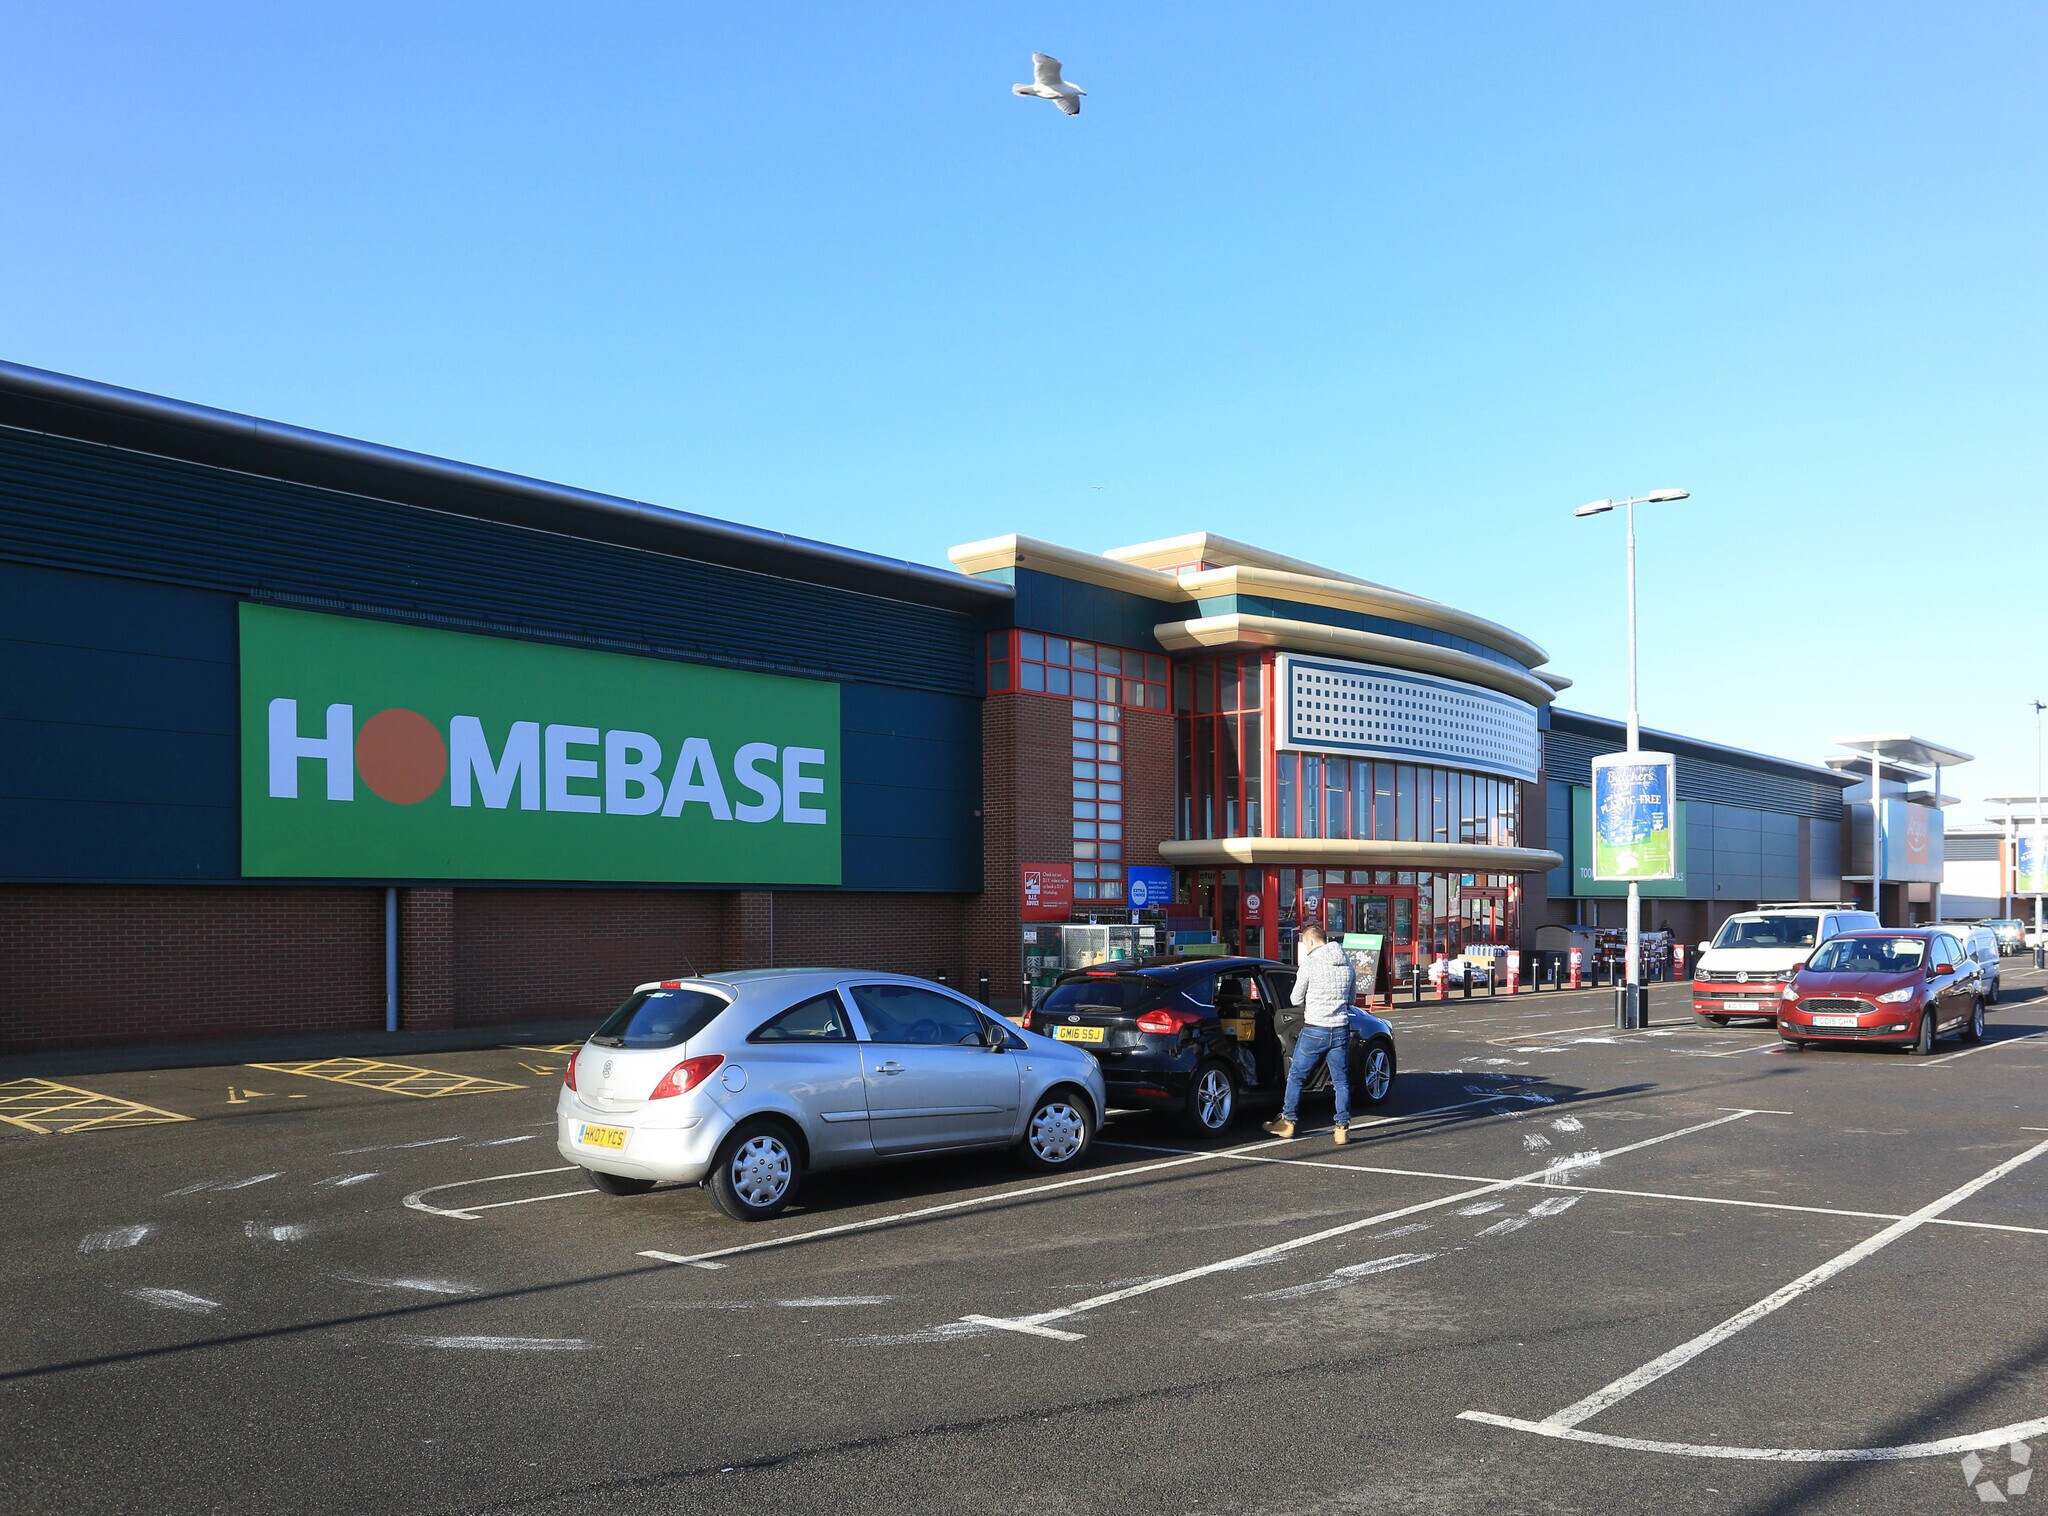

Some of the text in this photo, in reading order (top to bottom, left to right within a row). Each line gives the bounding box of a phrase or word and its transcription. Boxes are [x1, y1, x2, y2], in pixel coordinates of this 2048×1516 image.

[268, 697, 827, 826] HOMEBASE
[1580, 867, 1592, 878] TOO
[1819, 1018, 1855, 1026] GD15 GHN
[1060, 1028, 1100, 1040] GM16 SSJ
[584, 1127, 624, 1145] HK07 YCS
